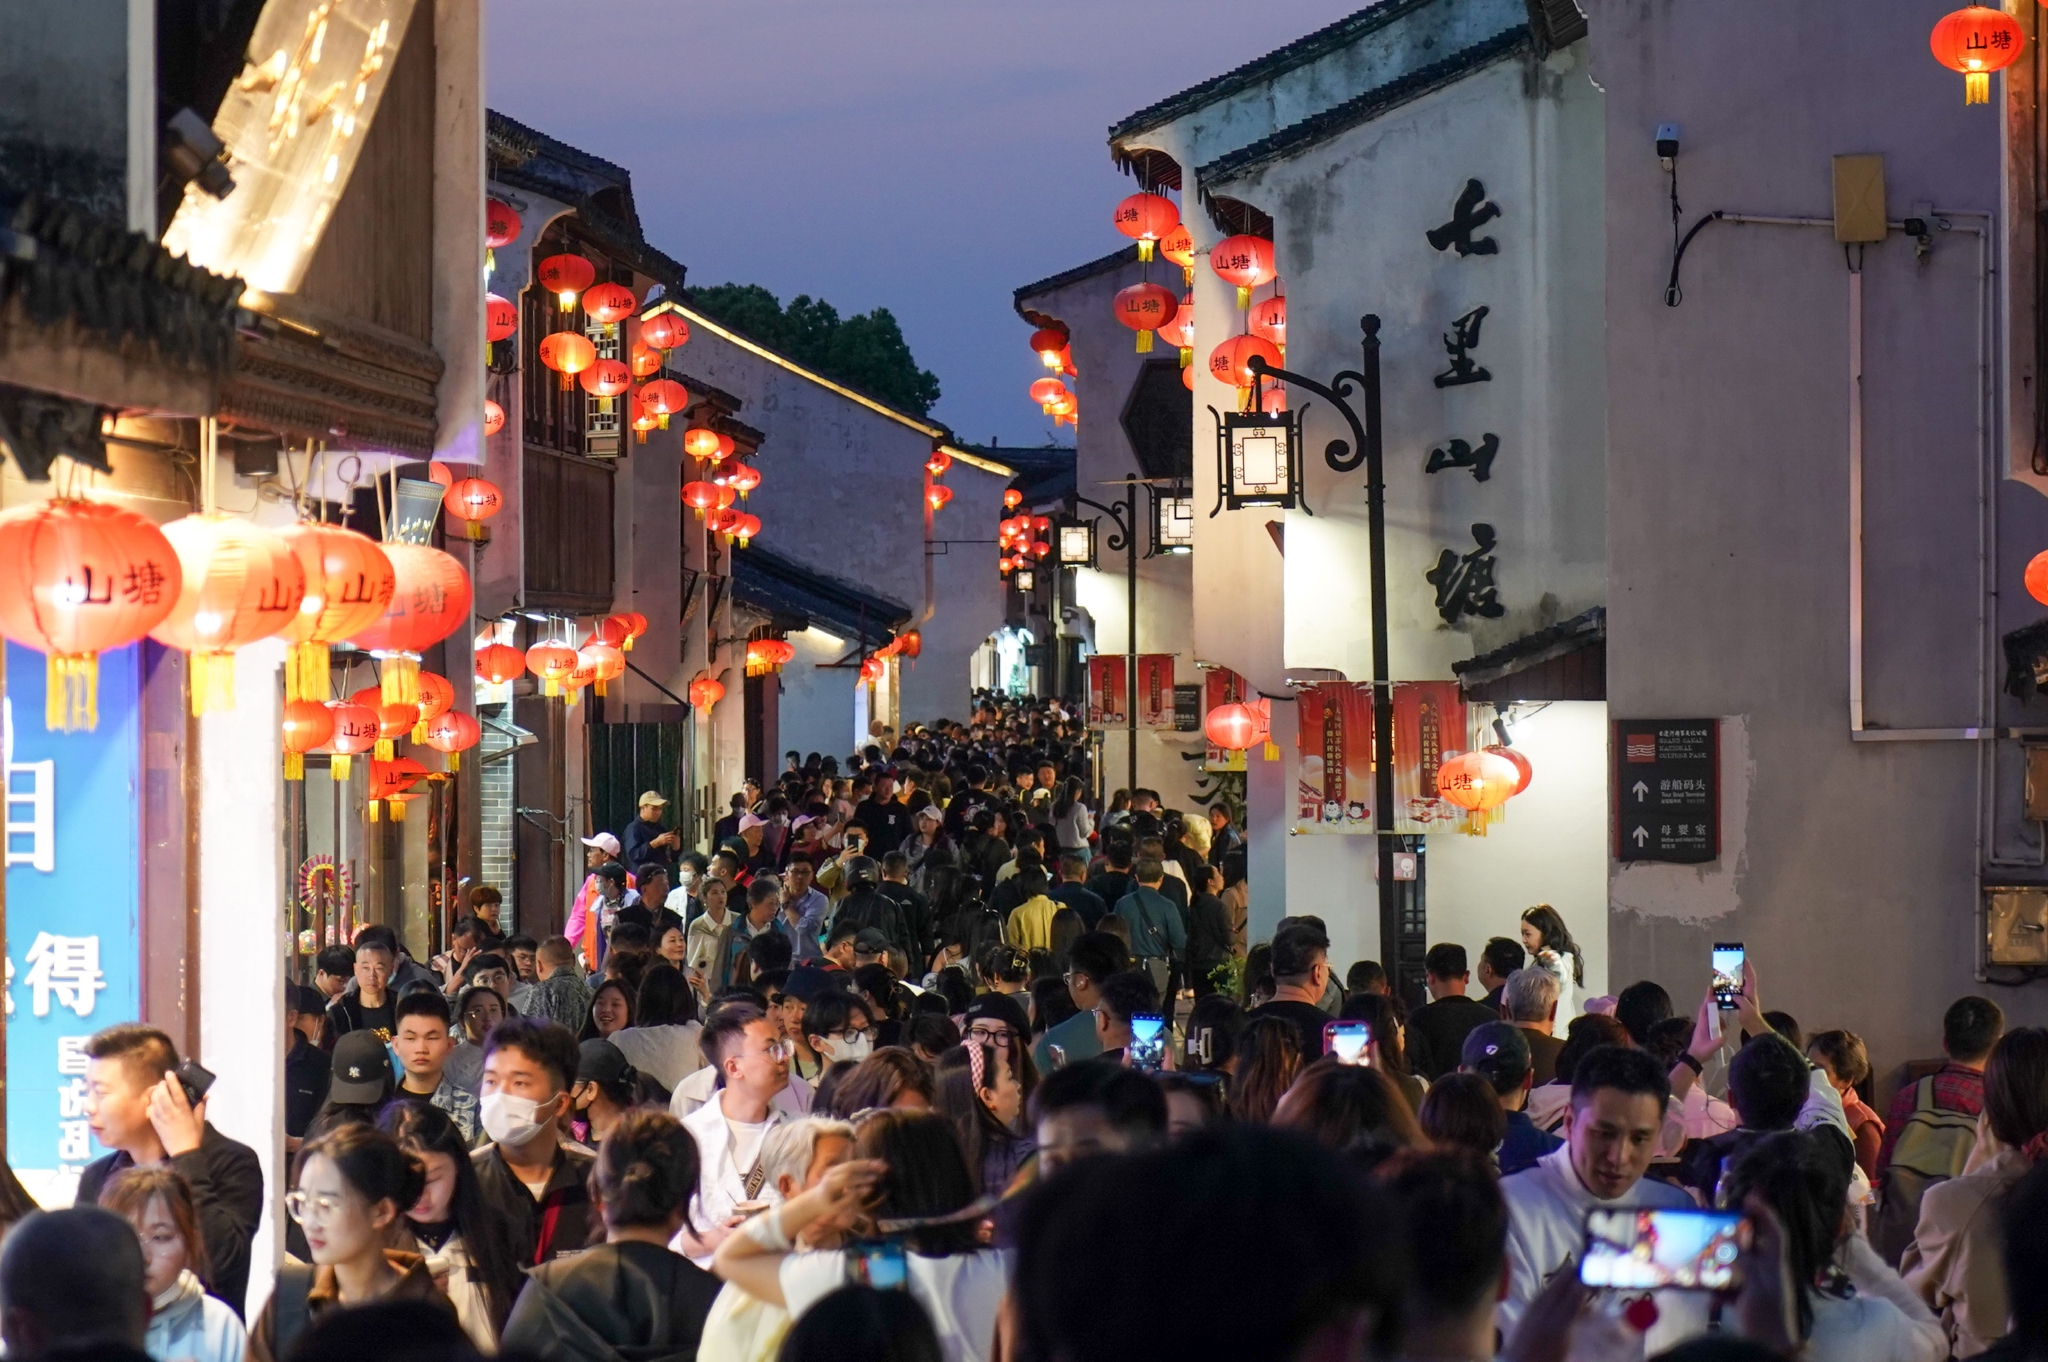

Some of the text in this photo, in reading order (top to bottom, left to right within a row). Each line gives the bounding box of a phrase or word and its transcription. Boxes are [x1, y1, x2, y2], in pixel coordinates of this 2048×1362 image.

[1966, 30, 2012, 50] 山塘
[1115, 208, 1139, 223] 山塘
[490, 220, 508, 236] 塘
[1165, 238, 1192, 252] 山塘
[1216, 255, 1251, 270] 山塘
[608, 297, 633, 309] 山塘
[1125, 299, 1161, 313] 山塘
[1210, 355, 1229, 371] 塘
[603, 372, 629, 384] 山塘
[641, 392, 659, 403] 山塘
[1426, 177, 1504, 623] 七里山塘
[470, 493, 497, 506] 山塘
[66, 561, 166, 606] 山塘
[550, 658, 575, 669] 山塘
[572, 667, 595, 679] 山塘
[343, 721, 378, 739] 山塘
[385, 771, 403, 786] 山
[1441, 773, 1473, 790] 山塘
[1660, 779, 1706, 790] 游船码头
[1661, 823, 1706, 835] 母婴室
[5, 929, 107, 1017] 得
